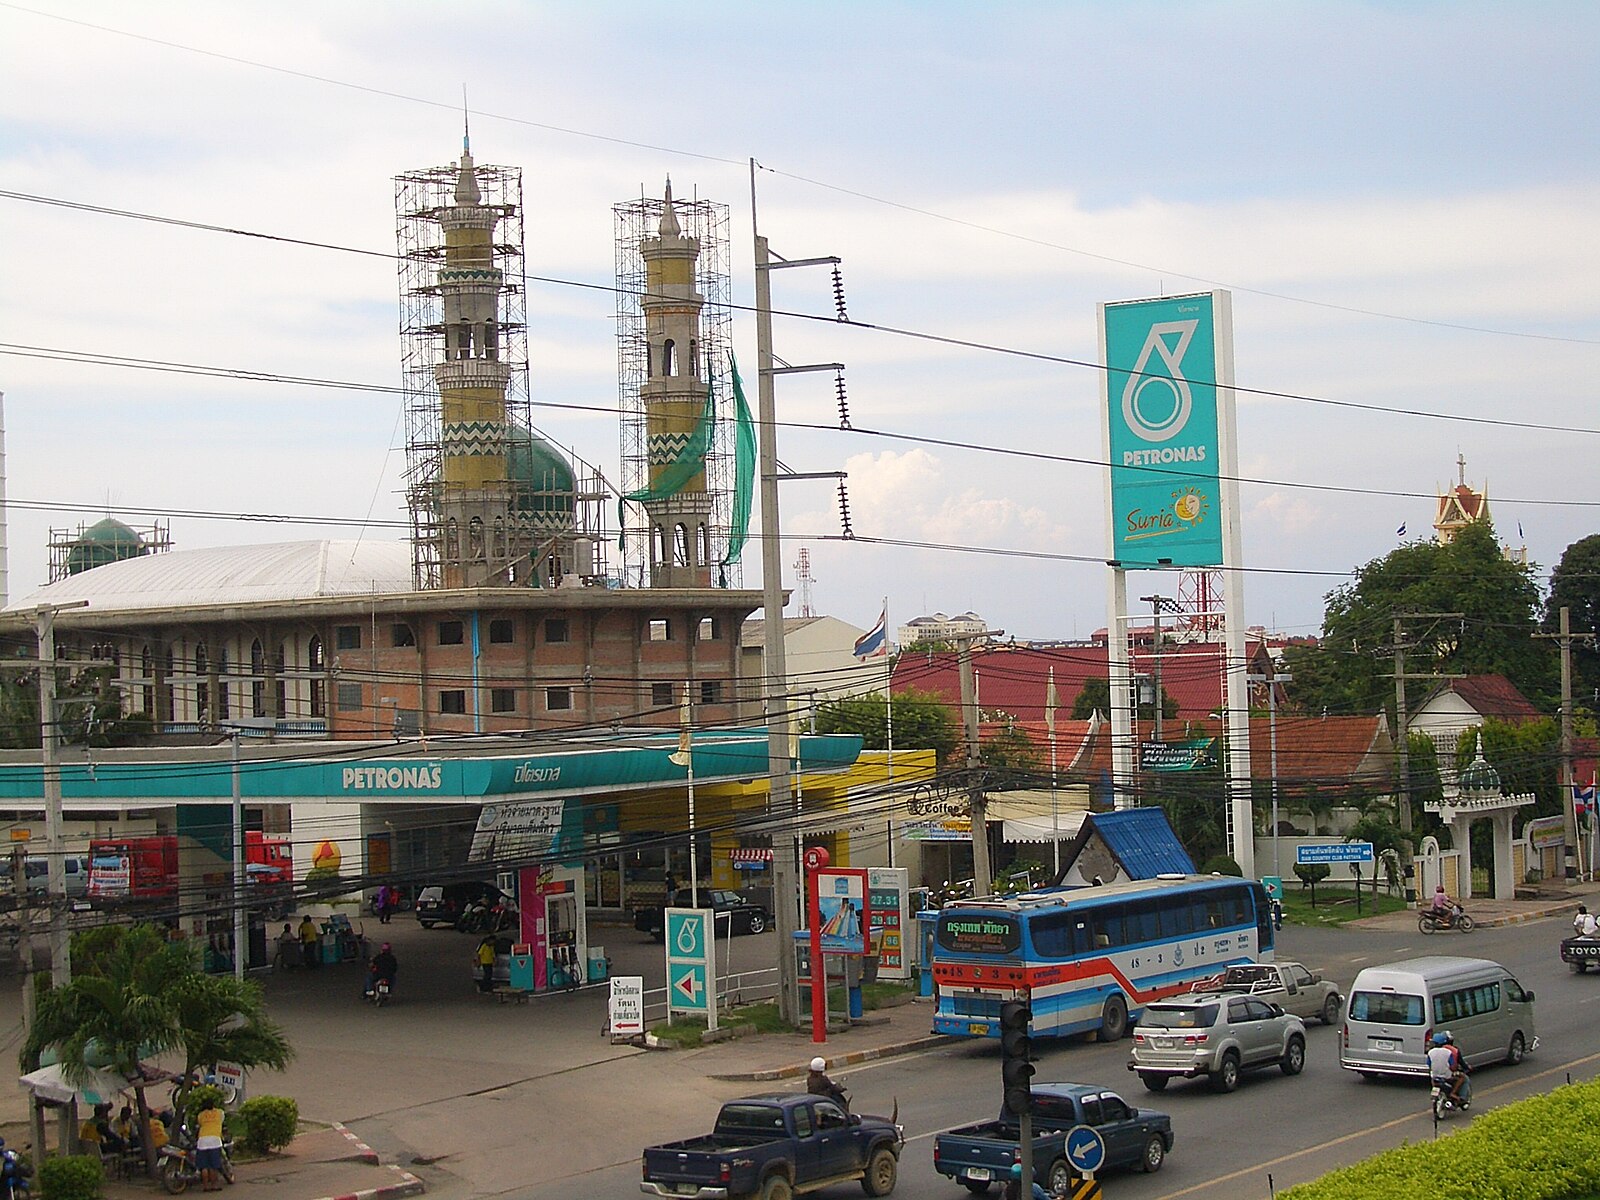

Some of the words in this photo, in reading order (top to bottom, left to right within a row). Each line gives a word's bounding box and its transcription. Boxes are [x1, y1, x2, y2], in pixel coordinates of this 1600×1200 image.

[1124, 446, 1206, 466] PETRONAS
[1126, 508, 1174, 532] Suria
[342, 767, 441, 789] PETRONAS
[514, 762, 561, 783] ปิโตรนาส
[925, 804, 960, 814] Coffee
[947, 922, 981, 937] กรุงเทพ
[983, 921, 1009, 935] พัทยา
[1158, 954, 1163, 963] 3
